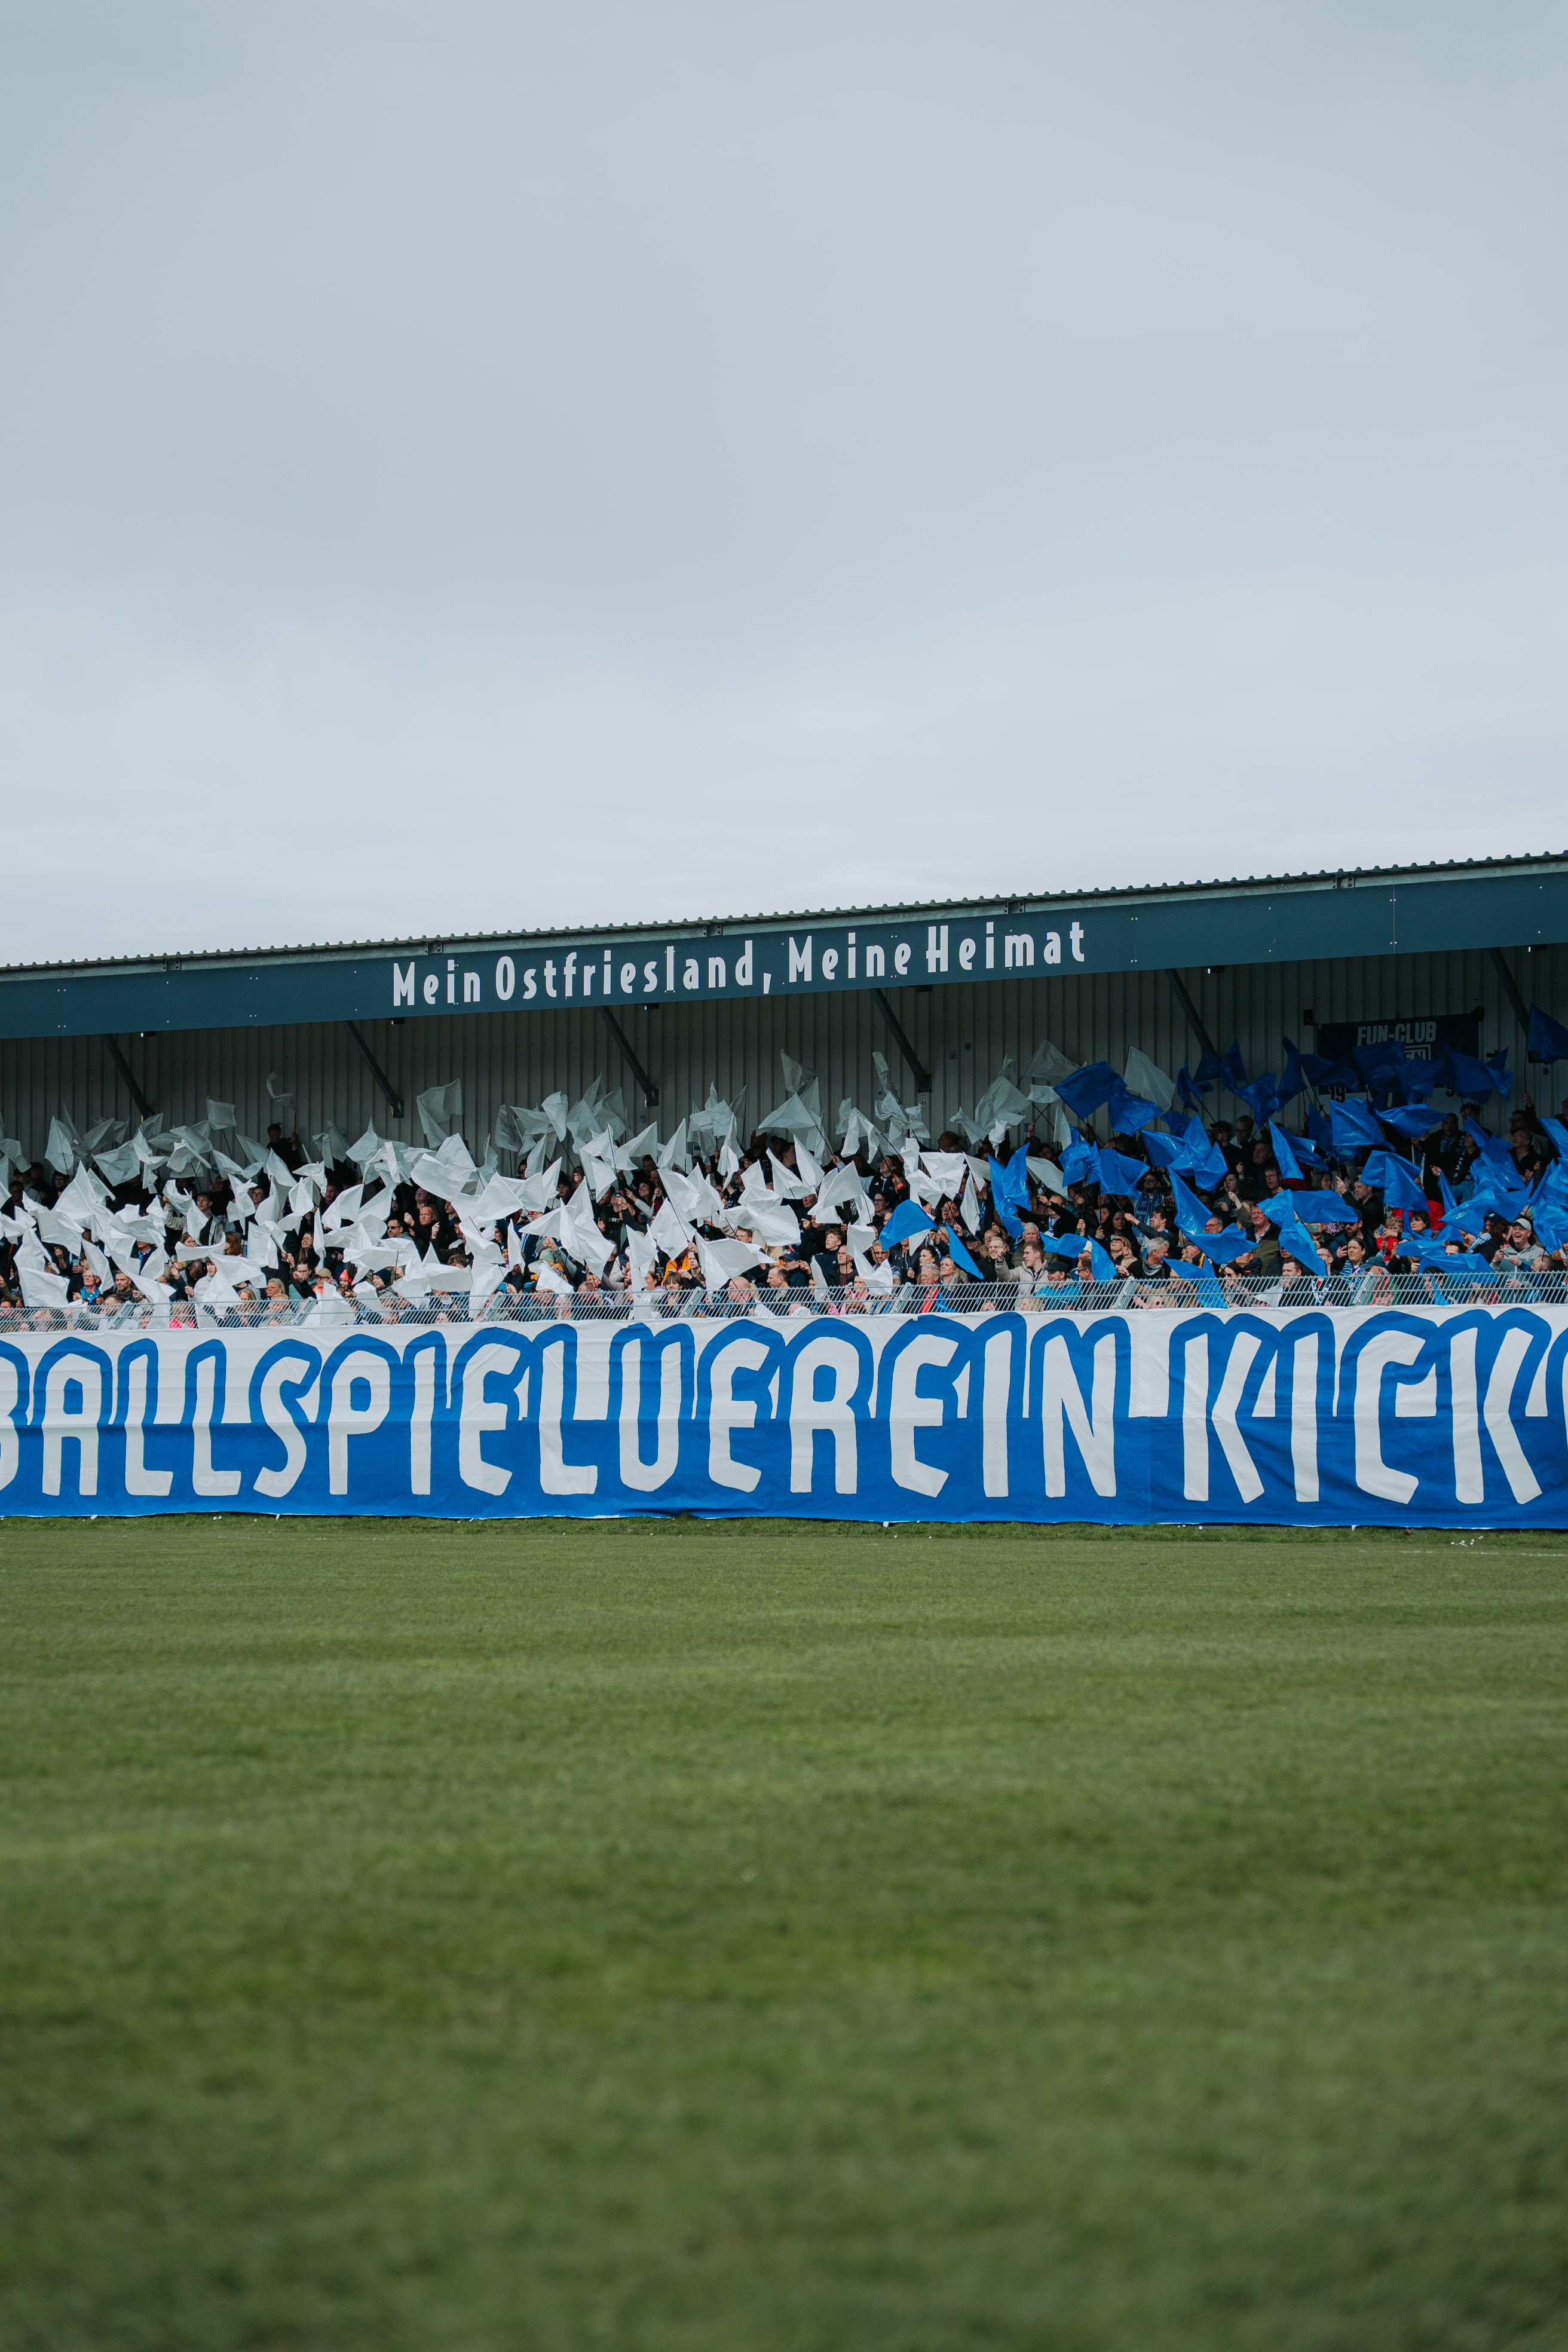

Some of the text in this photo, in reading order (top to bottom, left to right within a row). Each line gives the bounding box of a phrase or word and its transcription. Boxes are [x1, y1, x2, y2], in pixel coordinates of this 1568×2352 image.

[393, 921, 1085, 1006] Mein Ostfriesland, Meine Heimat
[1357, 1021, 1437, 1046] FUN-CLUB
[1183, 1326, 1568, 1505] KICK
